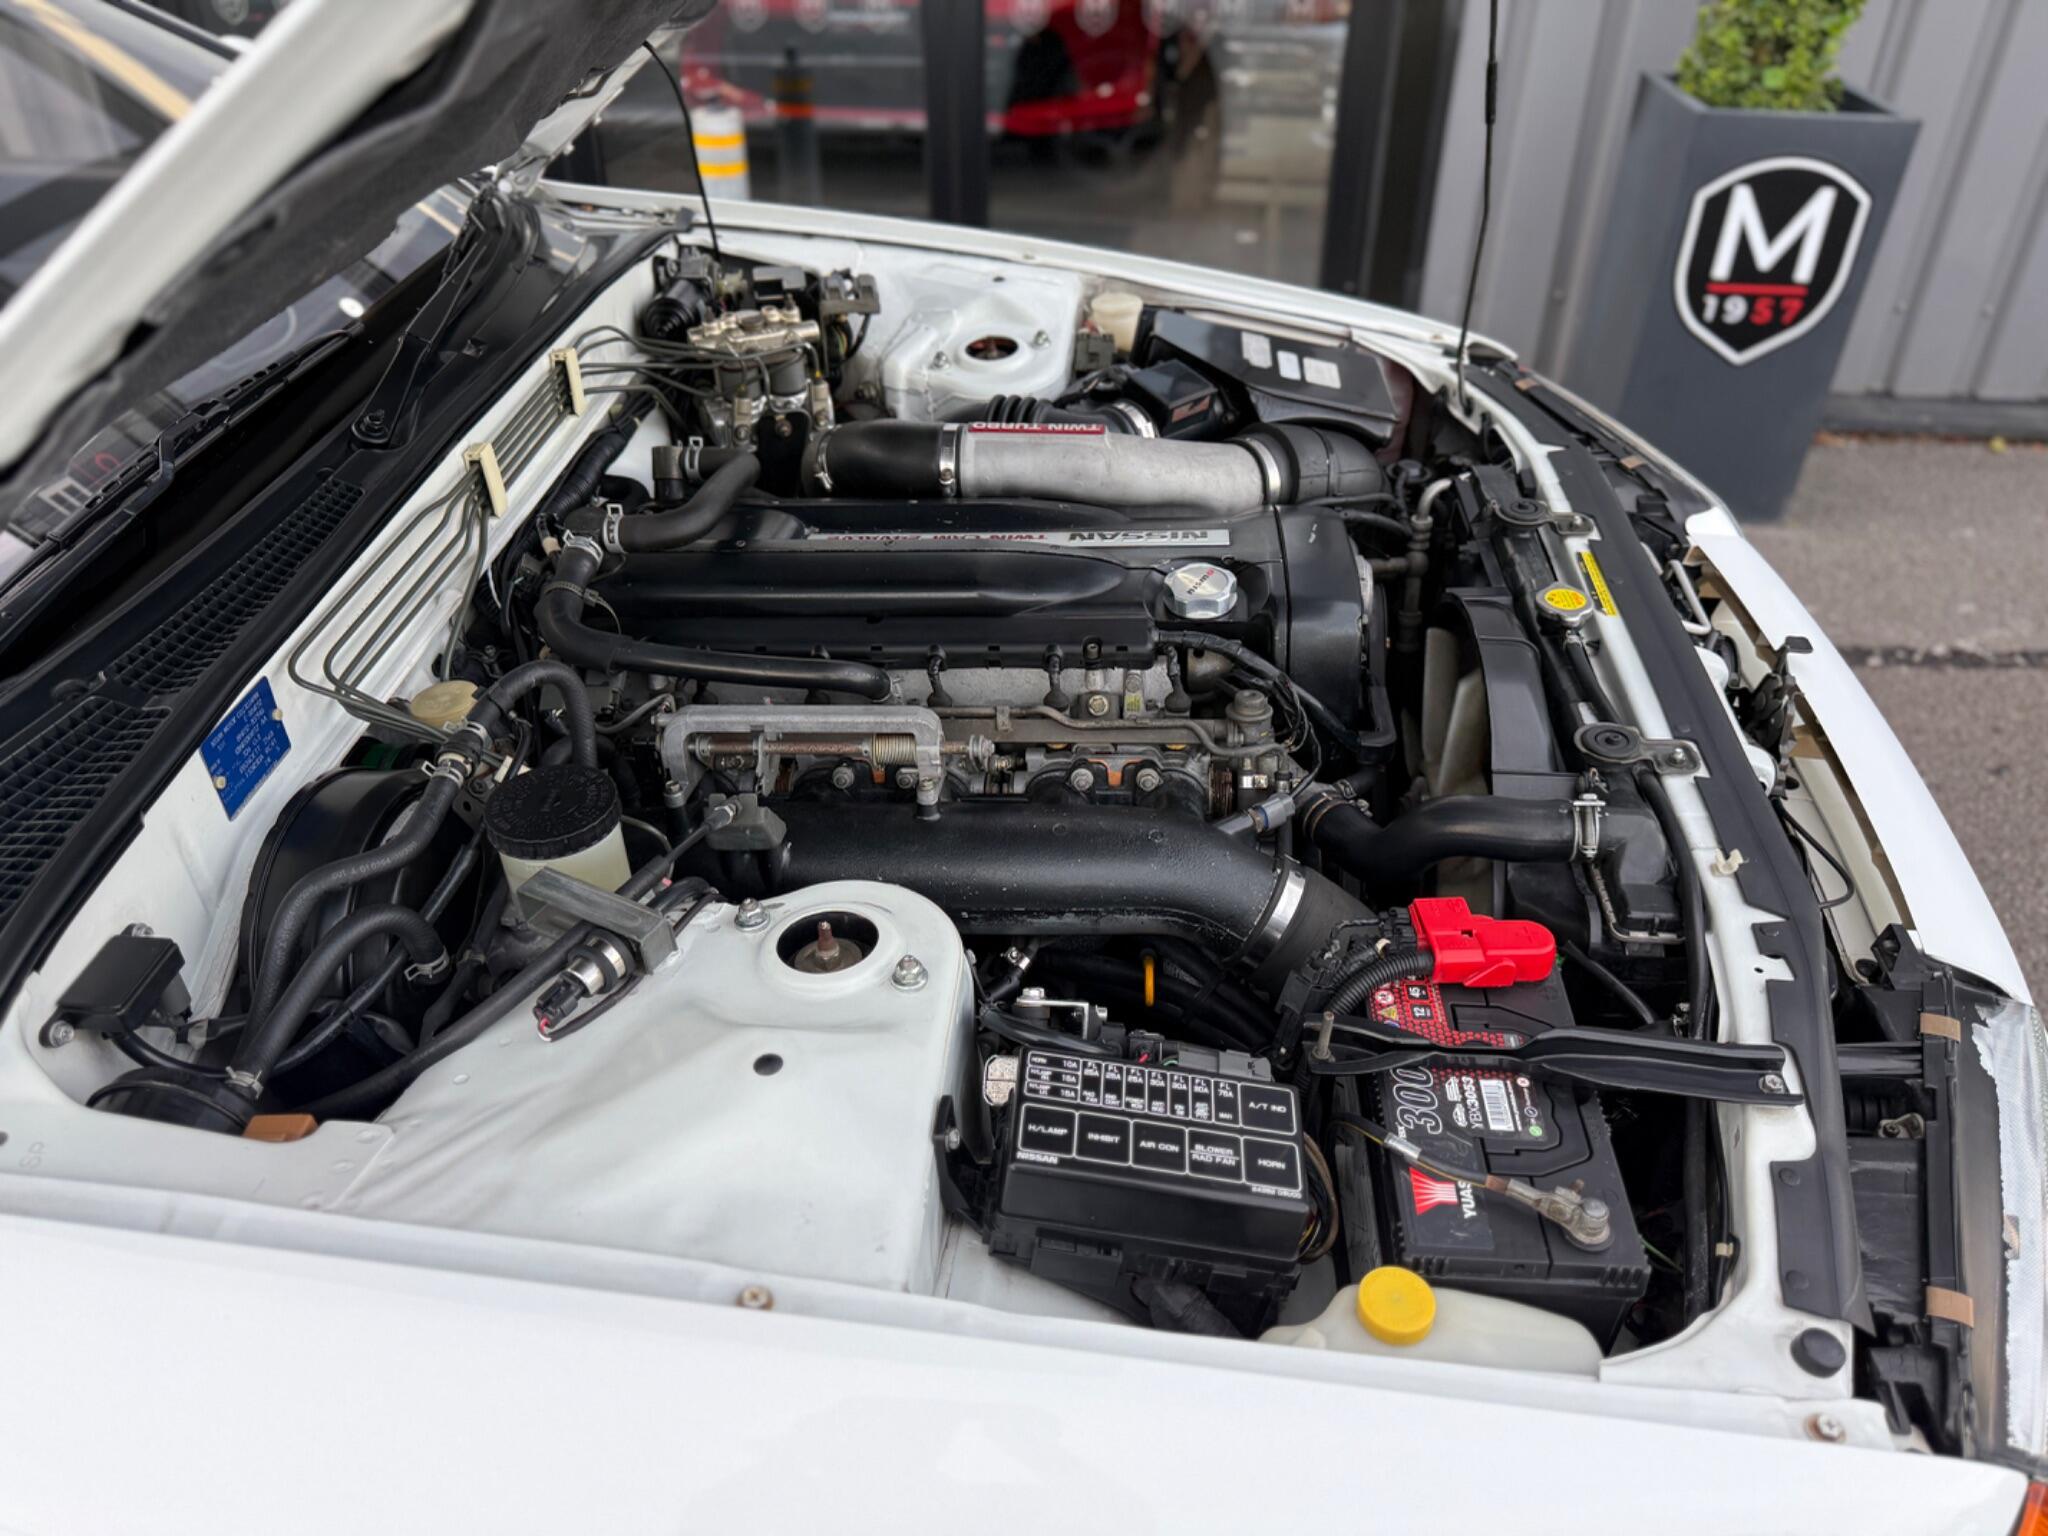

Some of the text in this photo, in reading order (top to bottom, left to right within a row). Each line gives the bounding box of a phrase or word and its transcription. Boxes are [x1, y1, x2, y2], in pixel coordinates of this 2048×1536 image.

[1709, 182, 1838, 284] M
[1702, 294, 1804, 326] 1957
[972, 421, 1100, 432] TWIN TURBO
[1069, 530, 1208, 543] NISSAN
[1389, 1066, 1444, 1134] 300
[1461, 1075, 1485, 1130] YBX3053
[1248, 1101, 1287, 1113] A/T IND
[1027, 1123, 1068, 1136] H/LAMP
[1139, 1140, 1180, 1153] AIR CON
[1194, 1144, 1234, 1155] BLOWER
[1016, 1151, 1059, 1165] NISSAN
[1191, 1153, 1236, 1167] RAD FAN
[1257, 1158, 1286, 1170] HORN
[1457, 1181, 1478, 1219] YUAS
